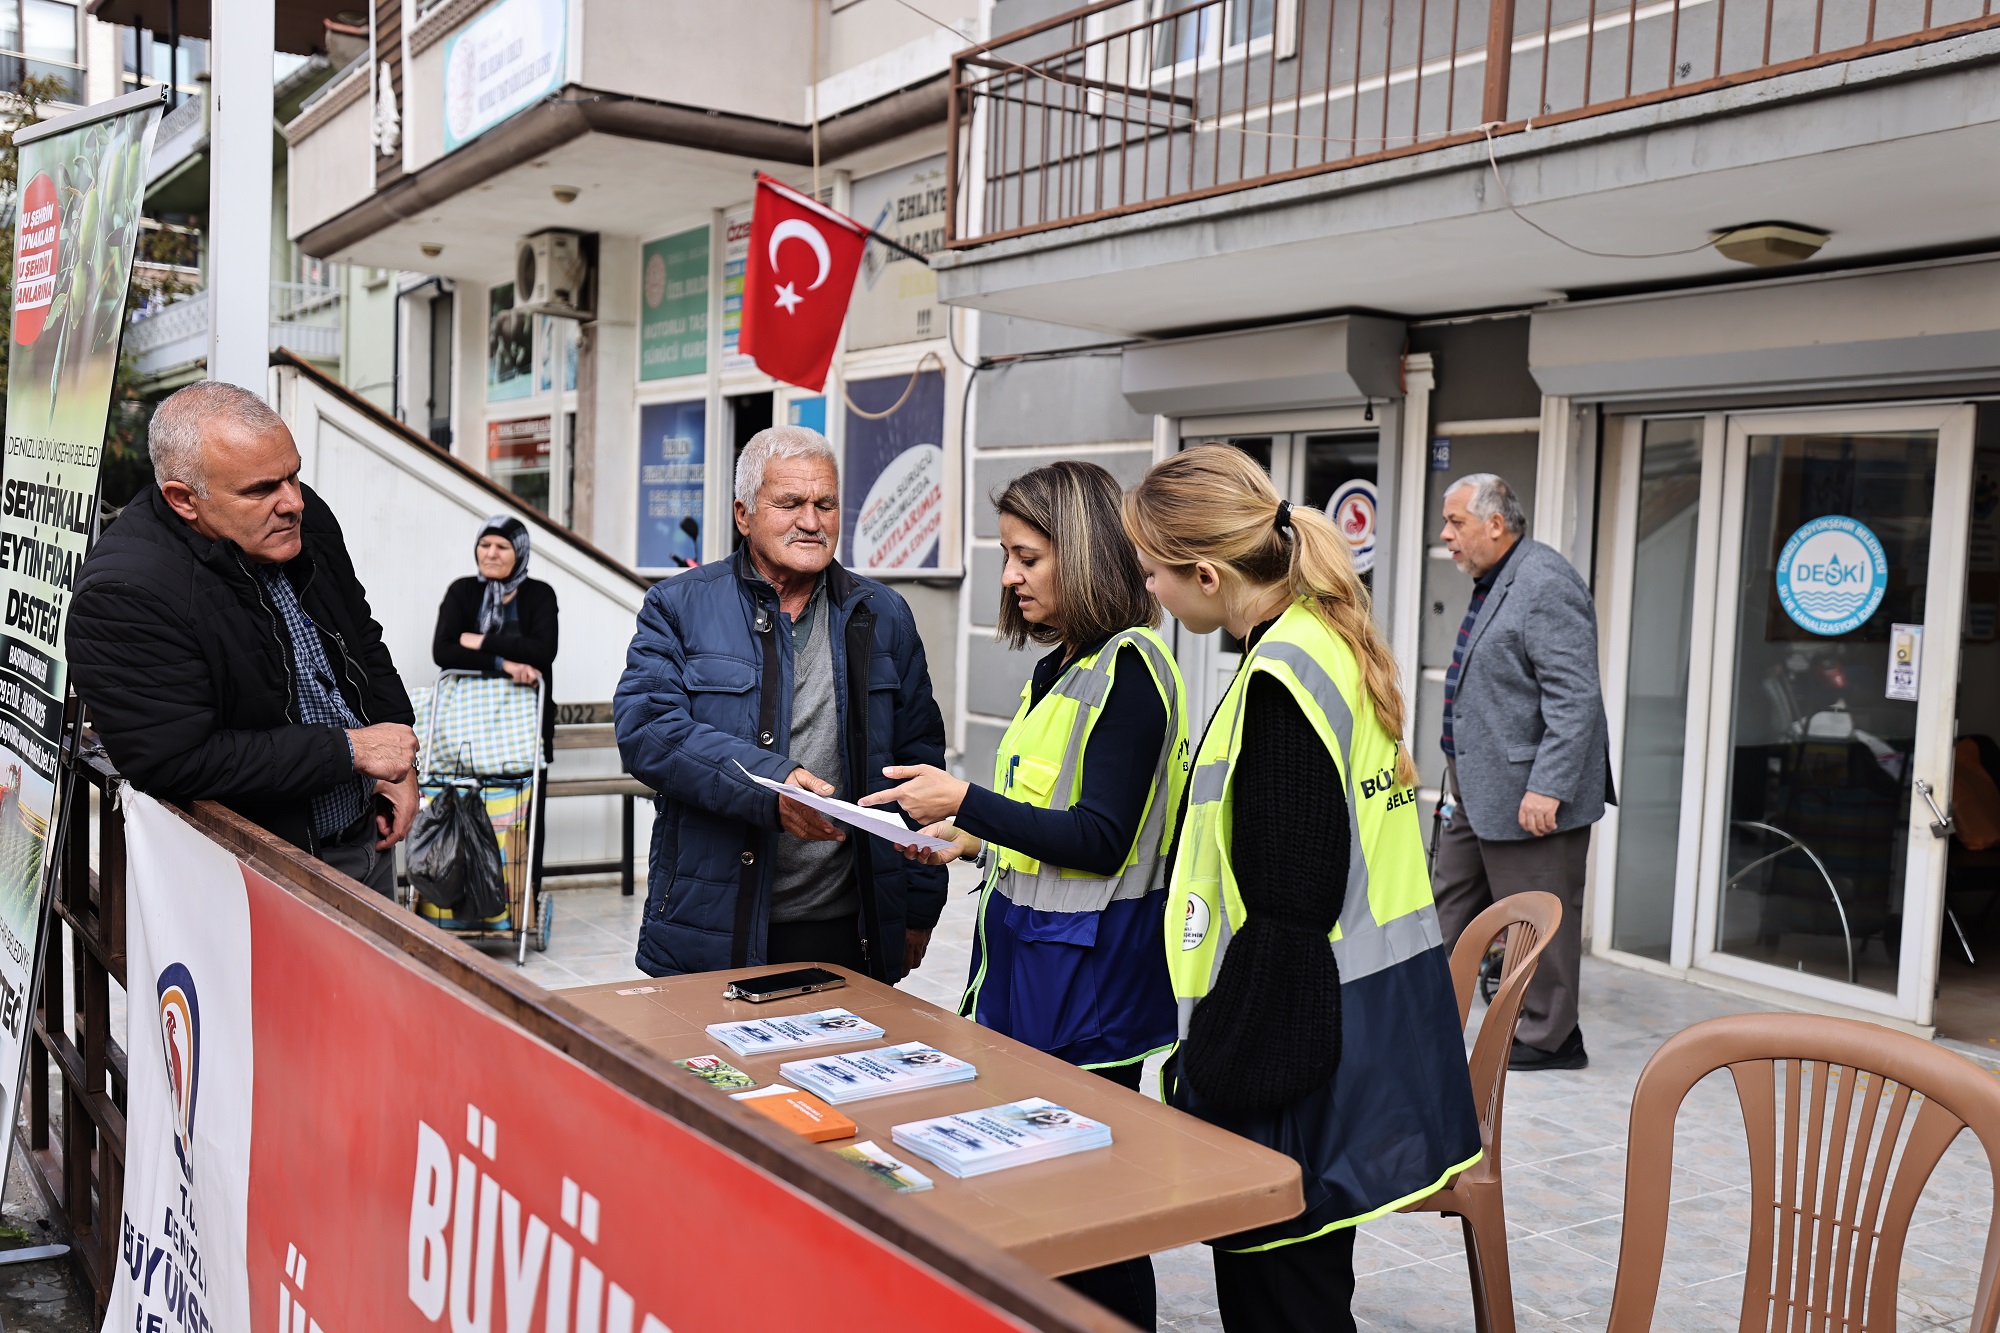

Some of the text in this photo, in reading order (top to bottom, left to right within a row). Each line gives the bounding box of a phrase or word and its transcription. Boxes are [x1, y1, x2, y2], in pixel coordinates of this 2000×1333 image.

[31, 201, 54, 230] ŞEHRİN
[25, 252, 50, 280] ŞEHRİN
[9, 436, 39, 458] DENİZLİ
[38, 438, 74, 466] BÜYÜKŞEHİR
[3, 471, 94, 535] SERTİFİKALI
[0, 525, 44, 580] EYTİN
[1779, 517, 1887, 575] DENİZLİ BÜYÜKŞEHİR BELEDİYESİ
[1797, 556, 1866, 586] DESKİ
[5, 588, 62, 648] DESTEĞİ
[1791, 607, 1860, 633] KANALİZASYON
[1386, 788, 1414, 811] BELE
[180, 1183, 198, 1237] T.C.
[408, 1103, 674, 1333] BÜYÜ
[164, 1206, 206, 1298] DENİZLİ
